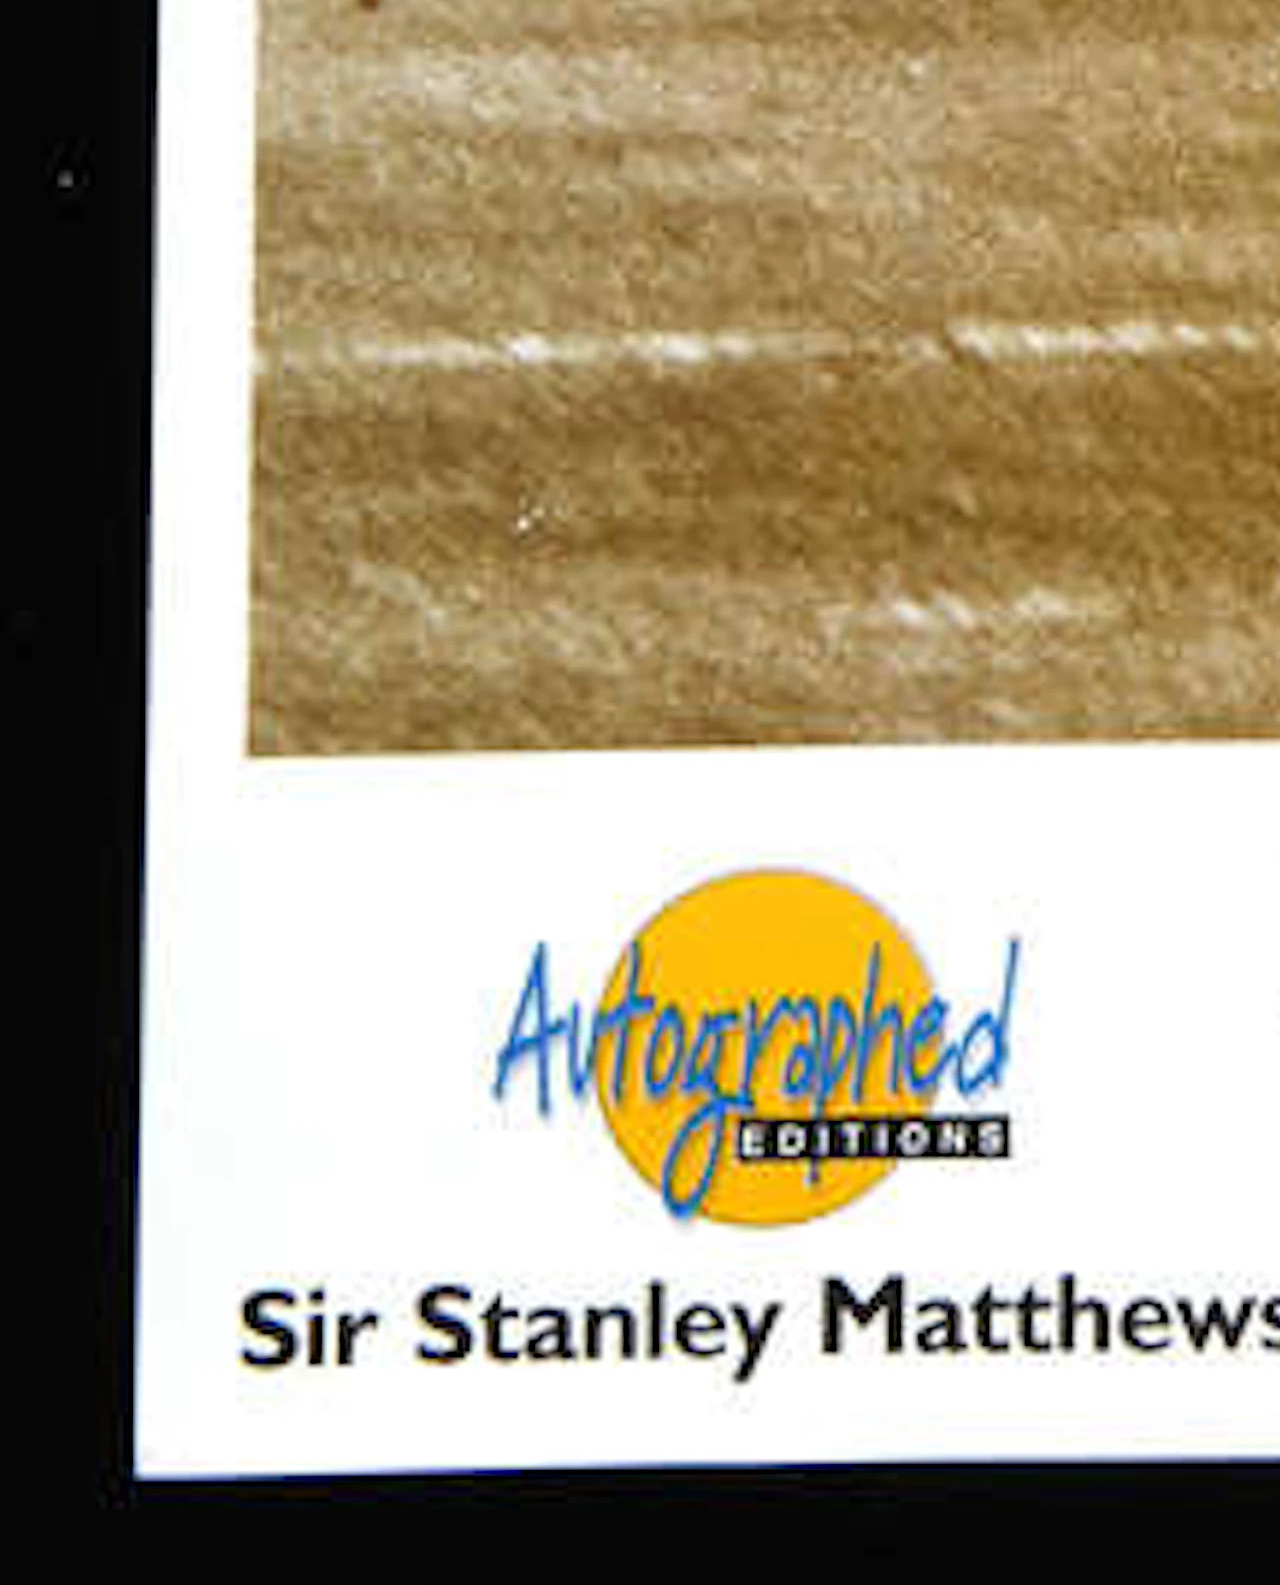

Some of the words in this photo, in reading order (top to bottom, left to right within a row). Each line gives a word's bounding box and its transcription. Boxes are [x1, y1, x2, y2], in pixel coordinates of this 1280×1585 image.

[491, 938, 1021, 1222] Autographed
[740, 1119, 1006, 1158] EDITIONS
[240, 1288, 380, 1370] Sir
[415, 1279, 784, 1385] Stanley
